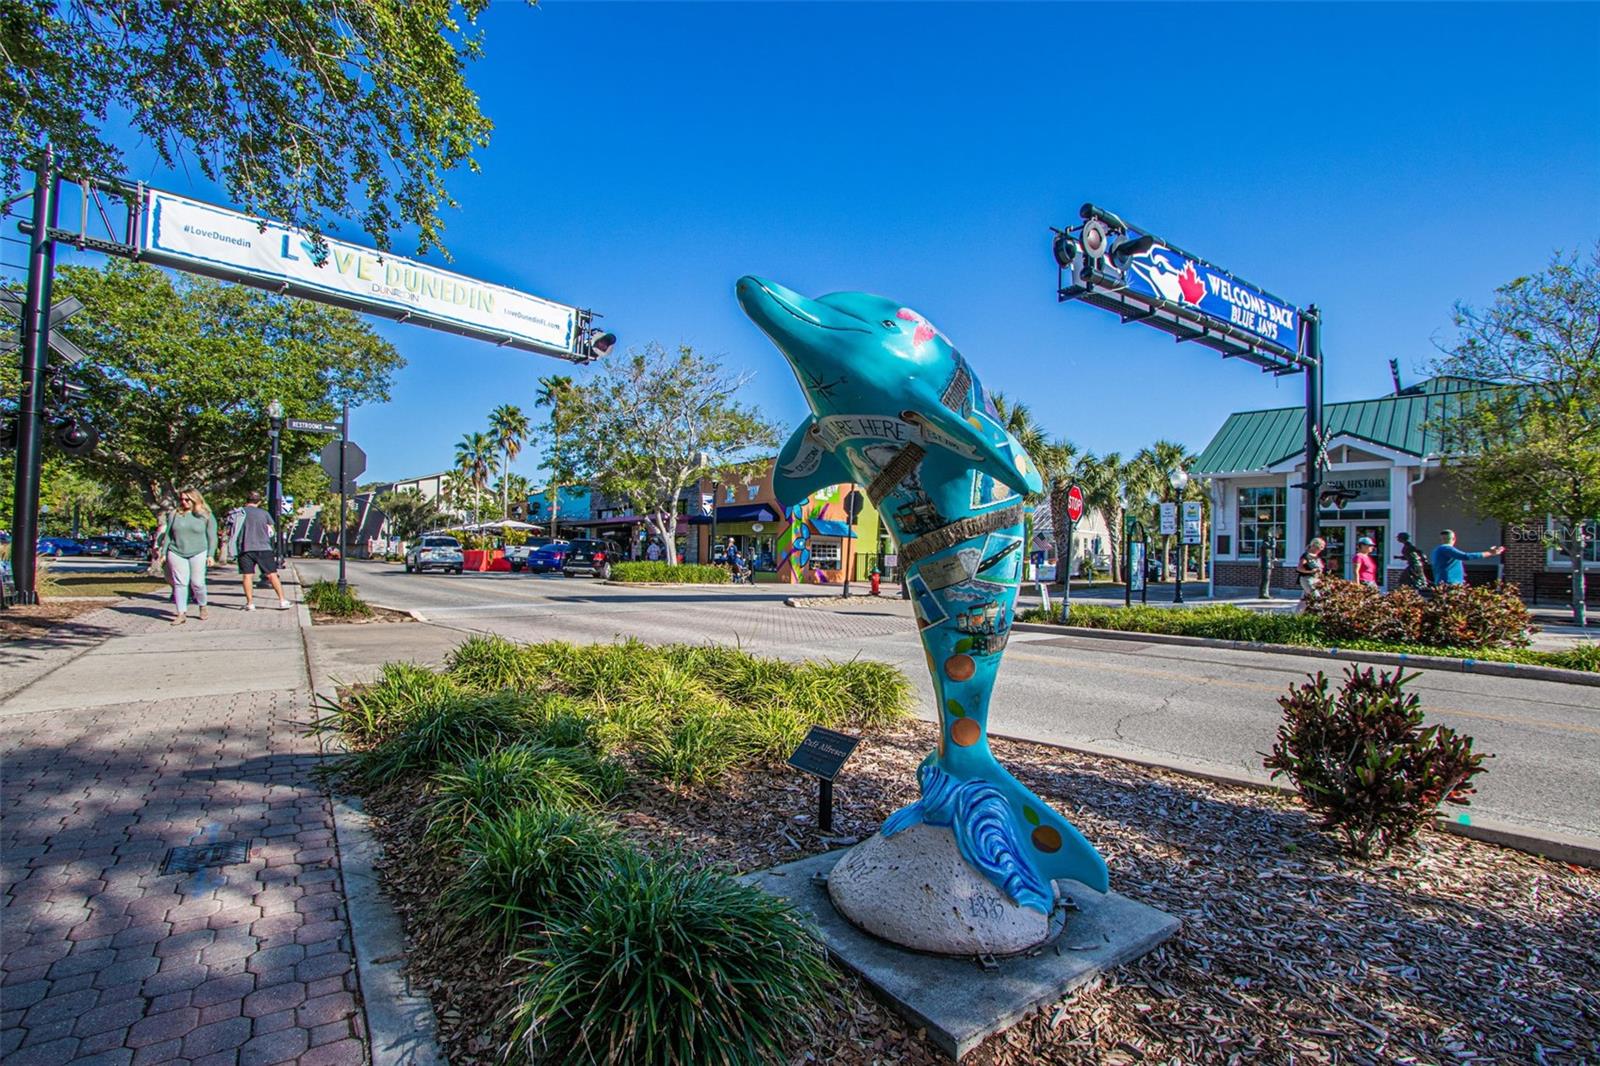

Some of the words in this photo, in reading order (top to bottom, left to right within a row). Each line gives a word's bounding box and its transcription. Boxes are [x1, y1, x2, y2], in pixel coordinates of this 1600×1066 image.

[184, 225, 252, 248] #LoveDunedin
[385, 263, 495, 313] DUNEDIN
[1206, 272, 1268, 318] WELCOME
[1267, 302, 1294, 331] BACK
[1231, 304, 1256, 331] BLUE
[1257, 316, 1278, 341] JAYS
[292, 421, 322, 430] RESTROOMS
[860, 418, 907, 442] HERE
[1347, 479, 1385, 489] HISTORY
[1068, 496, 1082, 511] STOP
